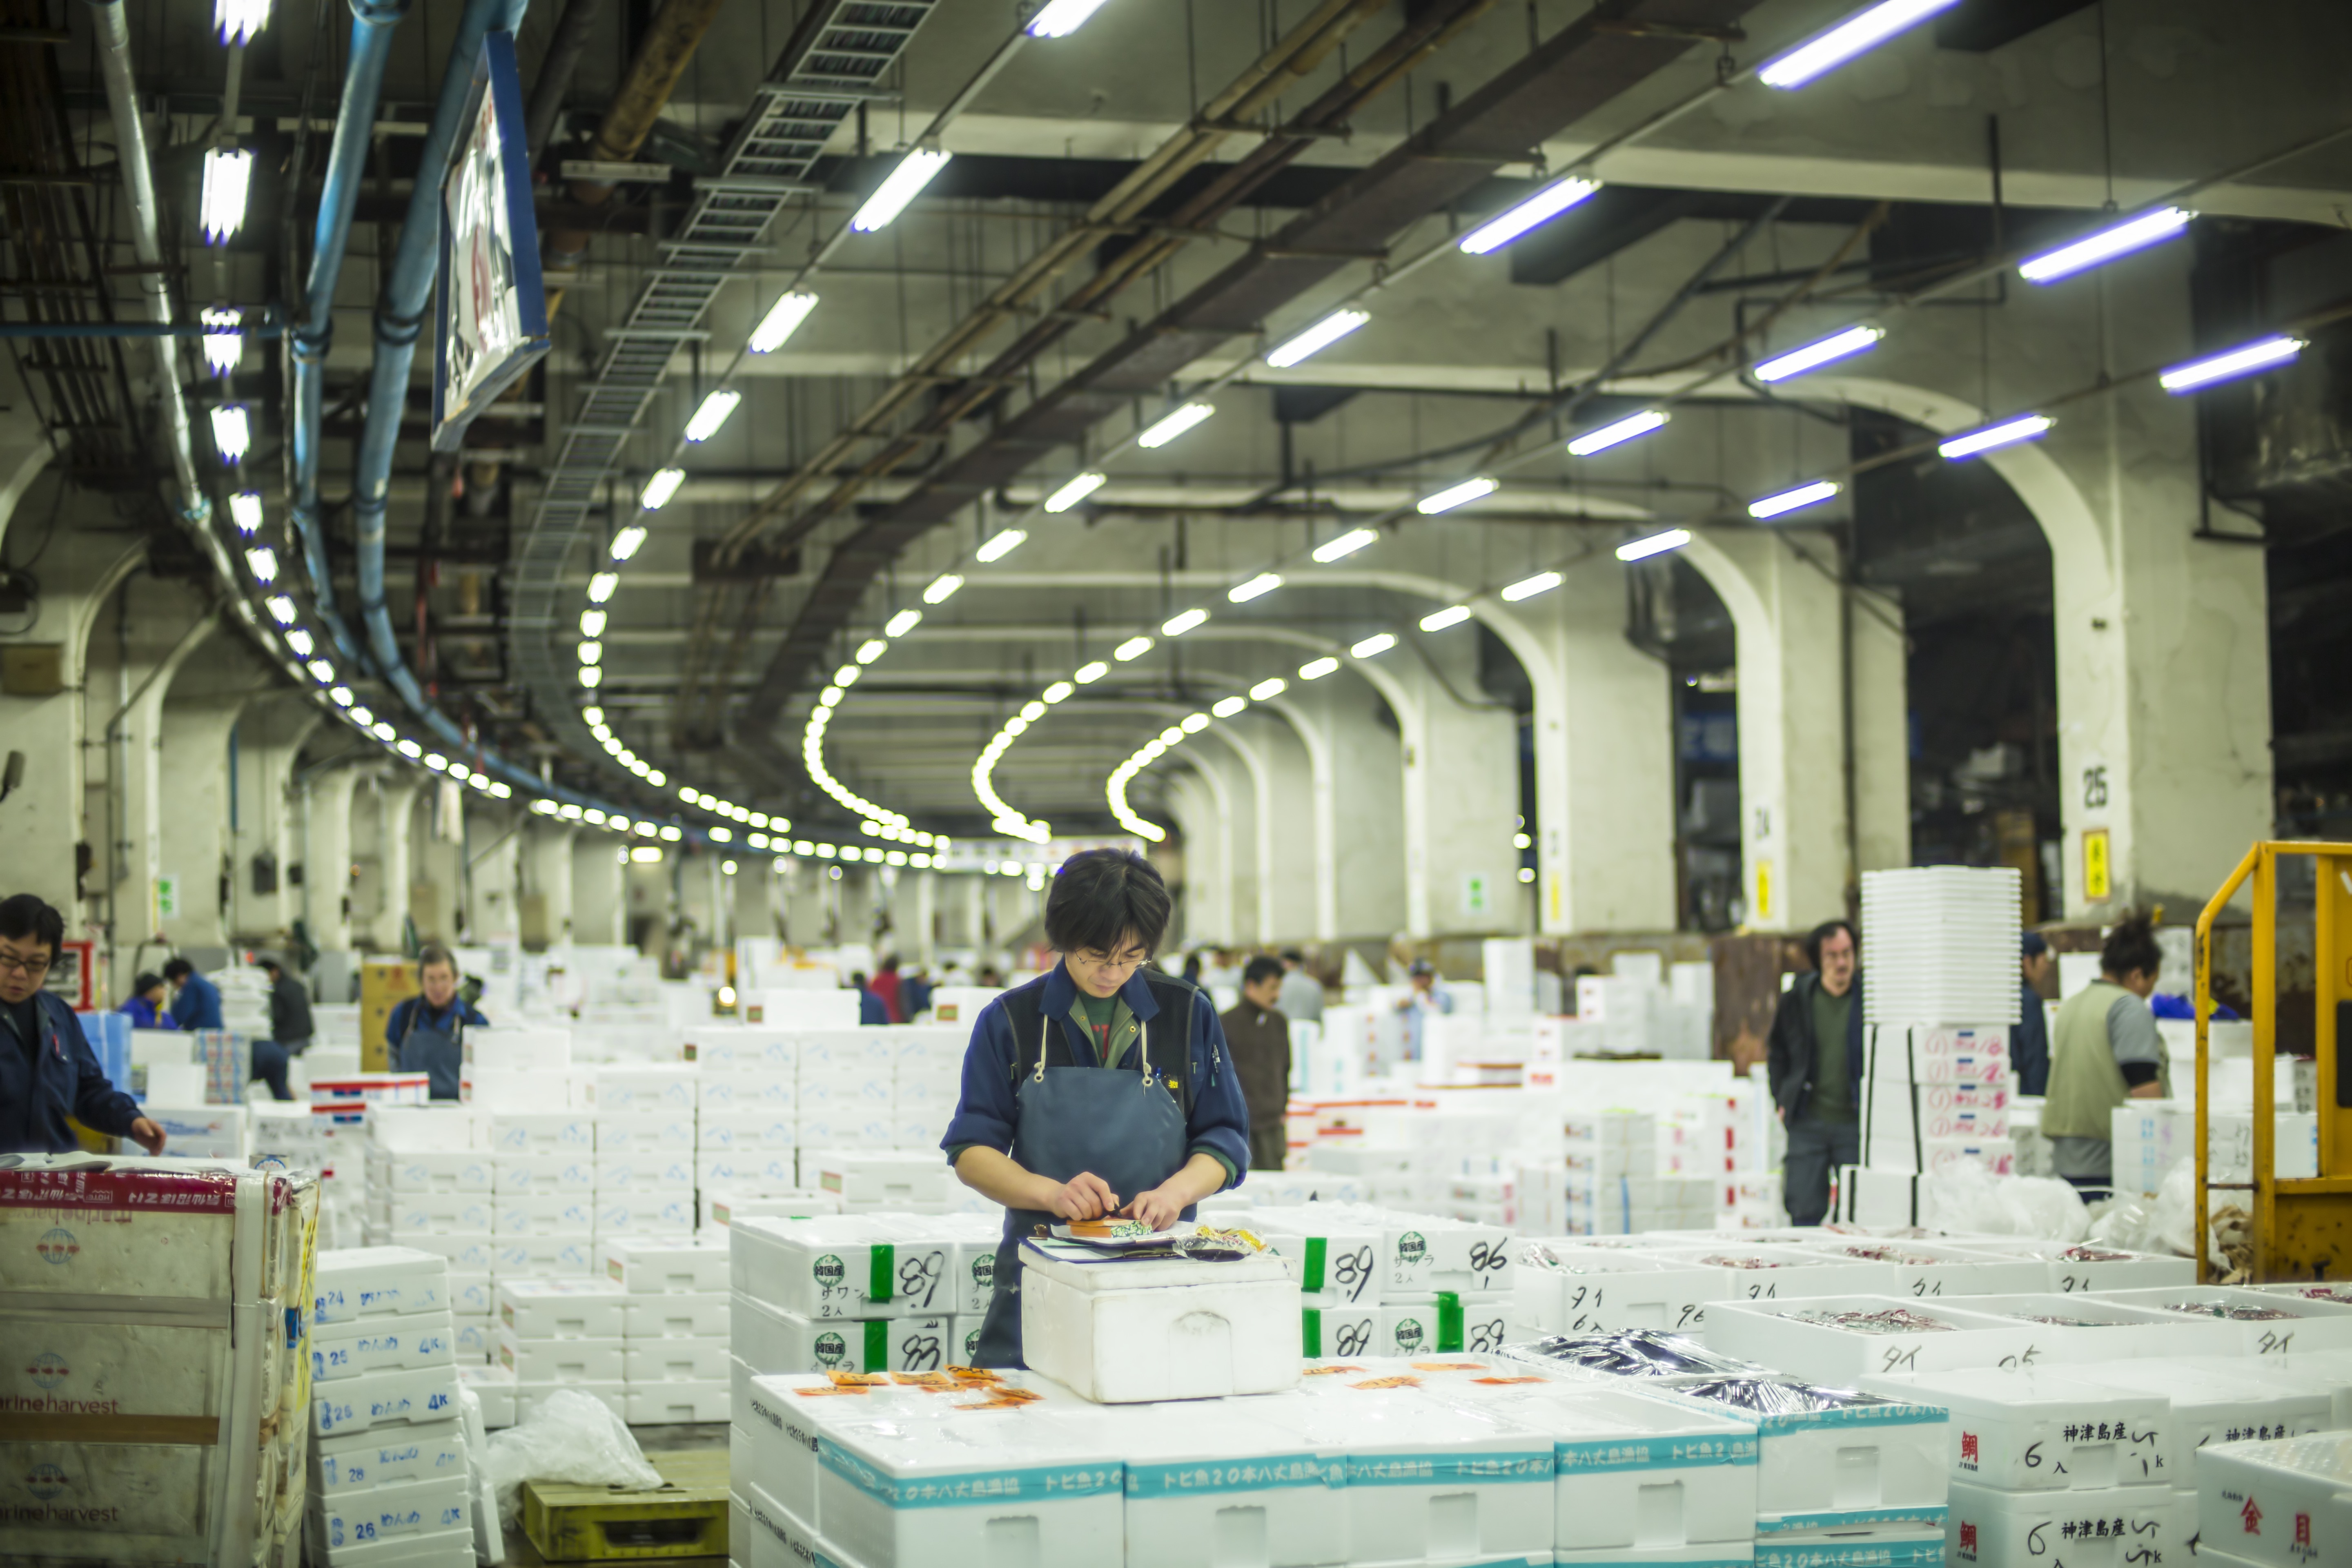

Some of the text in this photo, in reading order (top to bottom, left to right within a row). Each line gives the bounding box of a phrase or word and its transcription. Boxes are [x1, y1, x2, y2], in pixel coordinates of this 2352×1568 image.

[2084, 766, 2107, 808] 25
[1961, 1431, 1978, 1464] 鯛
[2063, 1421, 2127, 1442] 神津島産
[1960, 1520, 1977, 1555] 鯛
[2060, 1518, 2126, 1540] 神津島産
